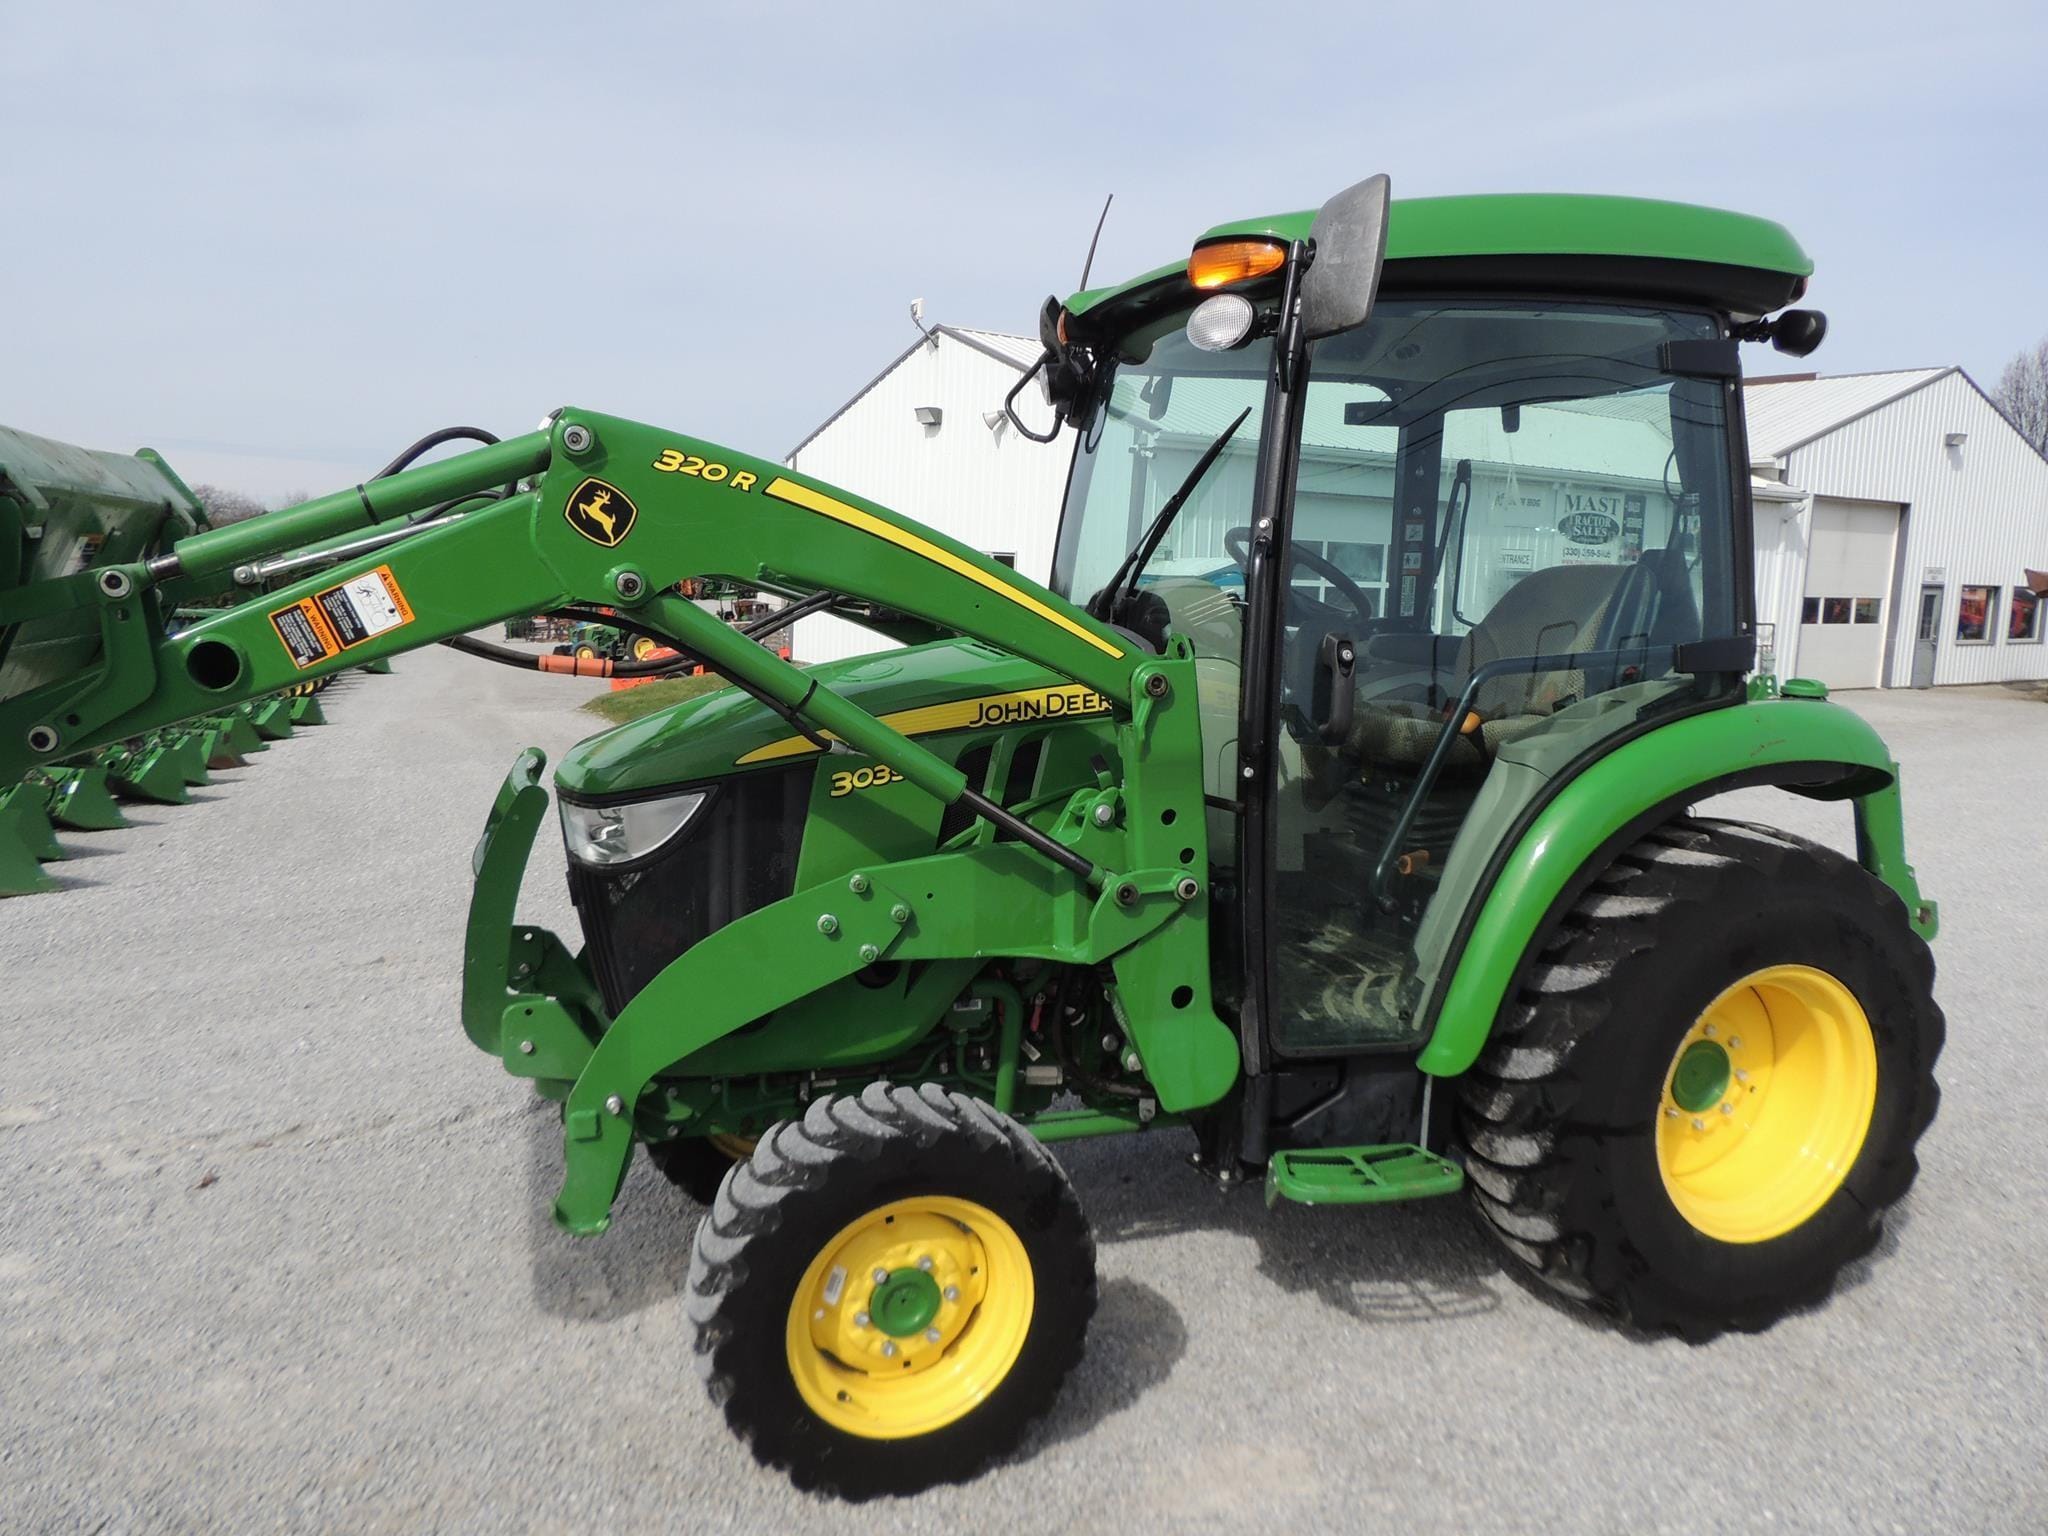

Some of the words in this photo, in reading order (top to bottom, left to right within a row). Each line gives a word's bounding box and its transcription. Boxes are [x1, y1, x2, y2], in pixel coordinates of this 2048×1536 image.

[652, 448, 730, 482] 320
[729, 470, 759, 493] R
[1564, 494, 1620, 515] MAST
[1572, 525, 1608, 538] SALES
[386, 580, 409, 617] WARNING
[310, 614, 333, 650] WARNING
[968, 698, 1042, 728] JOHN
